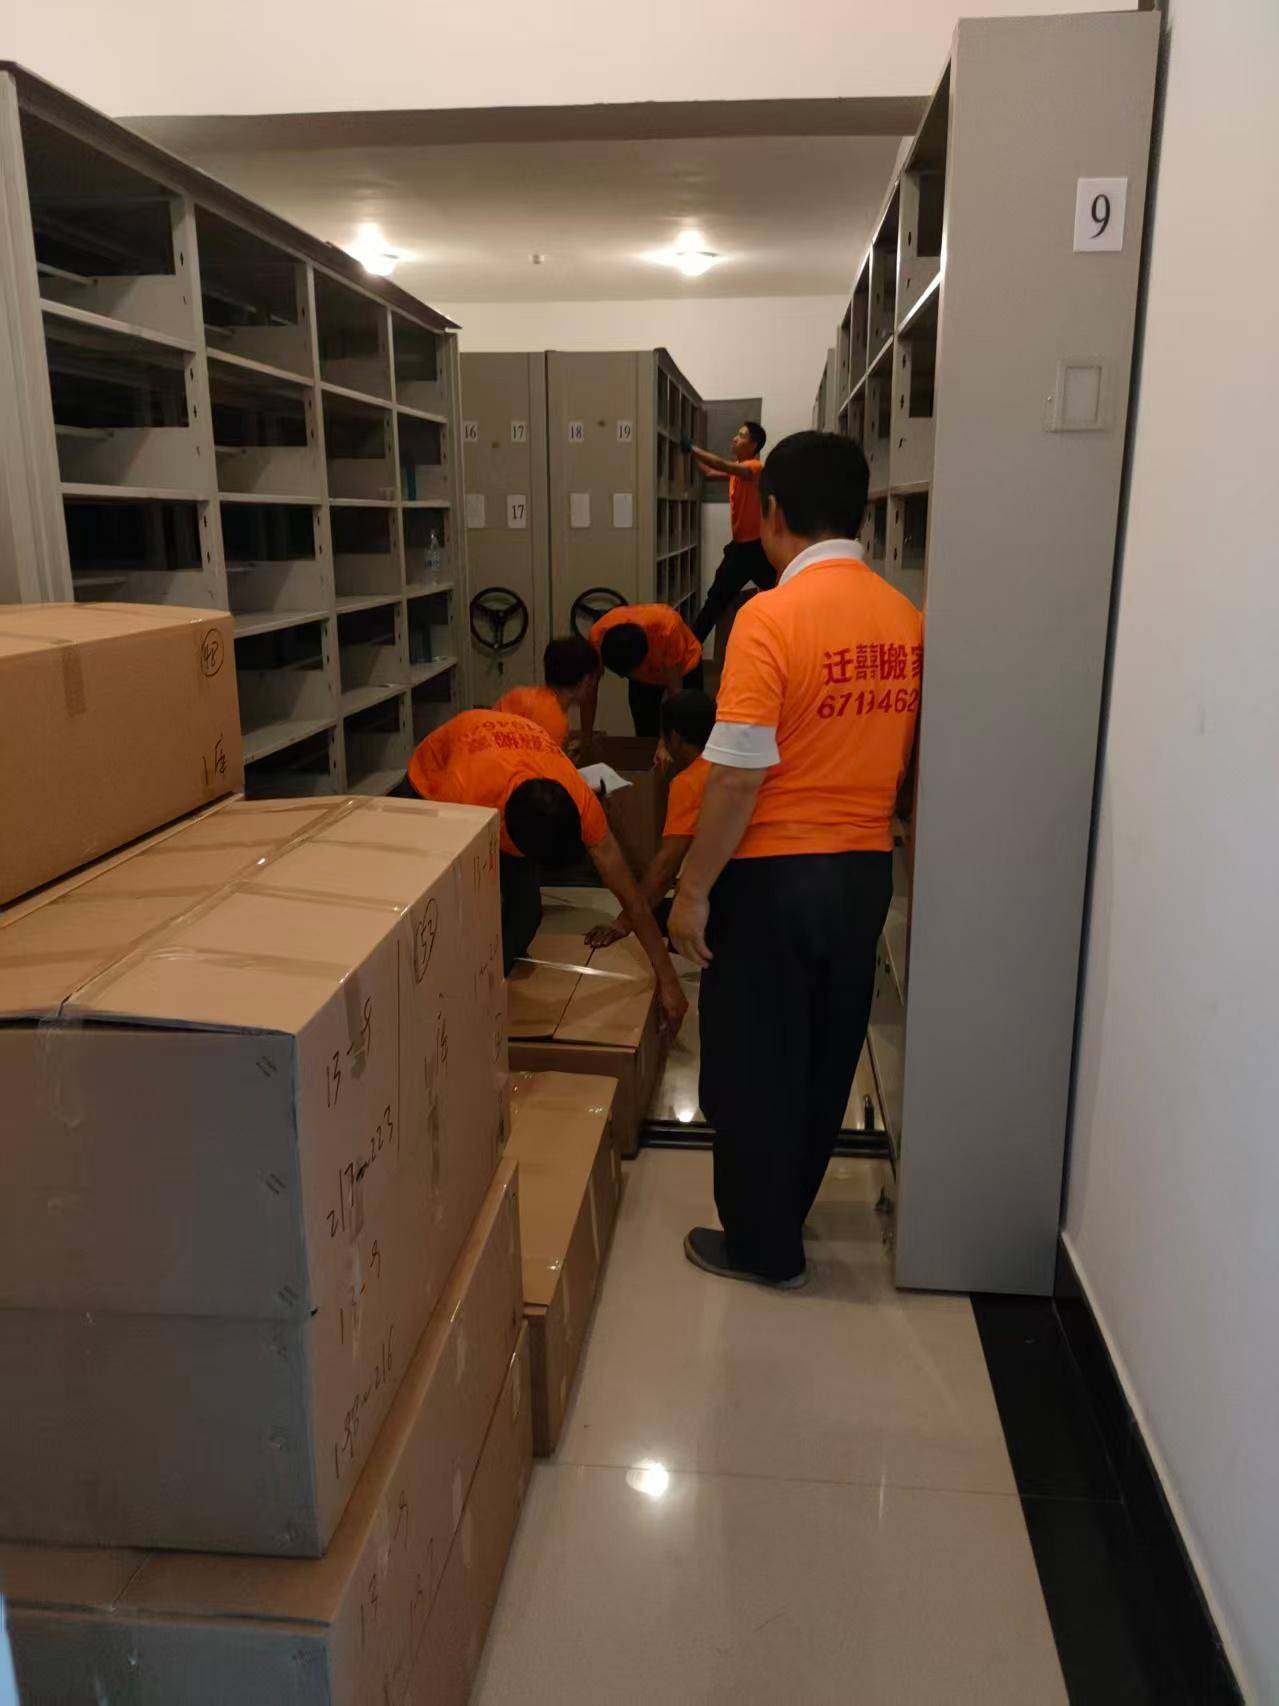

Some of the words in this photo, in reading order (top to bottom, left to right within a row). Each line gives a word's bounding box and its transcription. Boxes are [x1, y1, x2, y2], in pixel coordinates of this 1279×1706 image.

[1088, 193, 1111, 240] 9
[464, 424, 477, 440] 16
[512, 424, 525, 440] 17
[569, 424, 582, 440] 18
[618, 424, 631, 440] 19
[511, 504, 525, 521] 17
